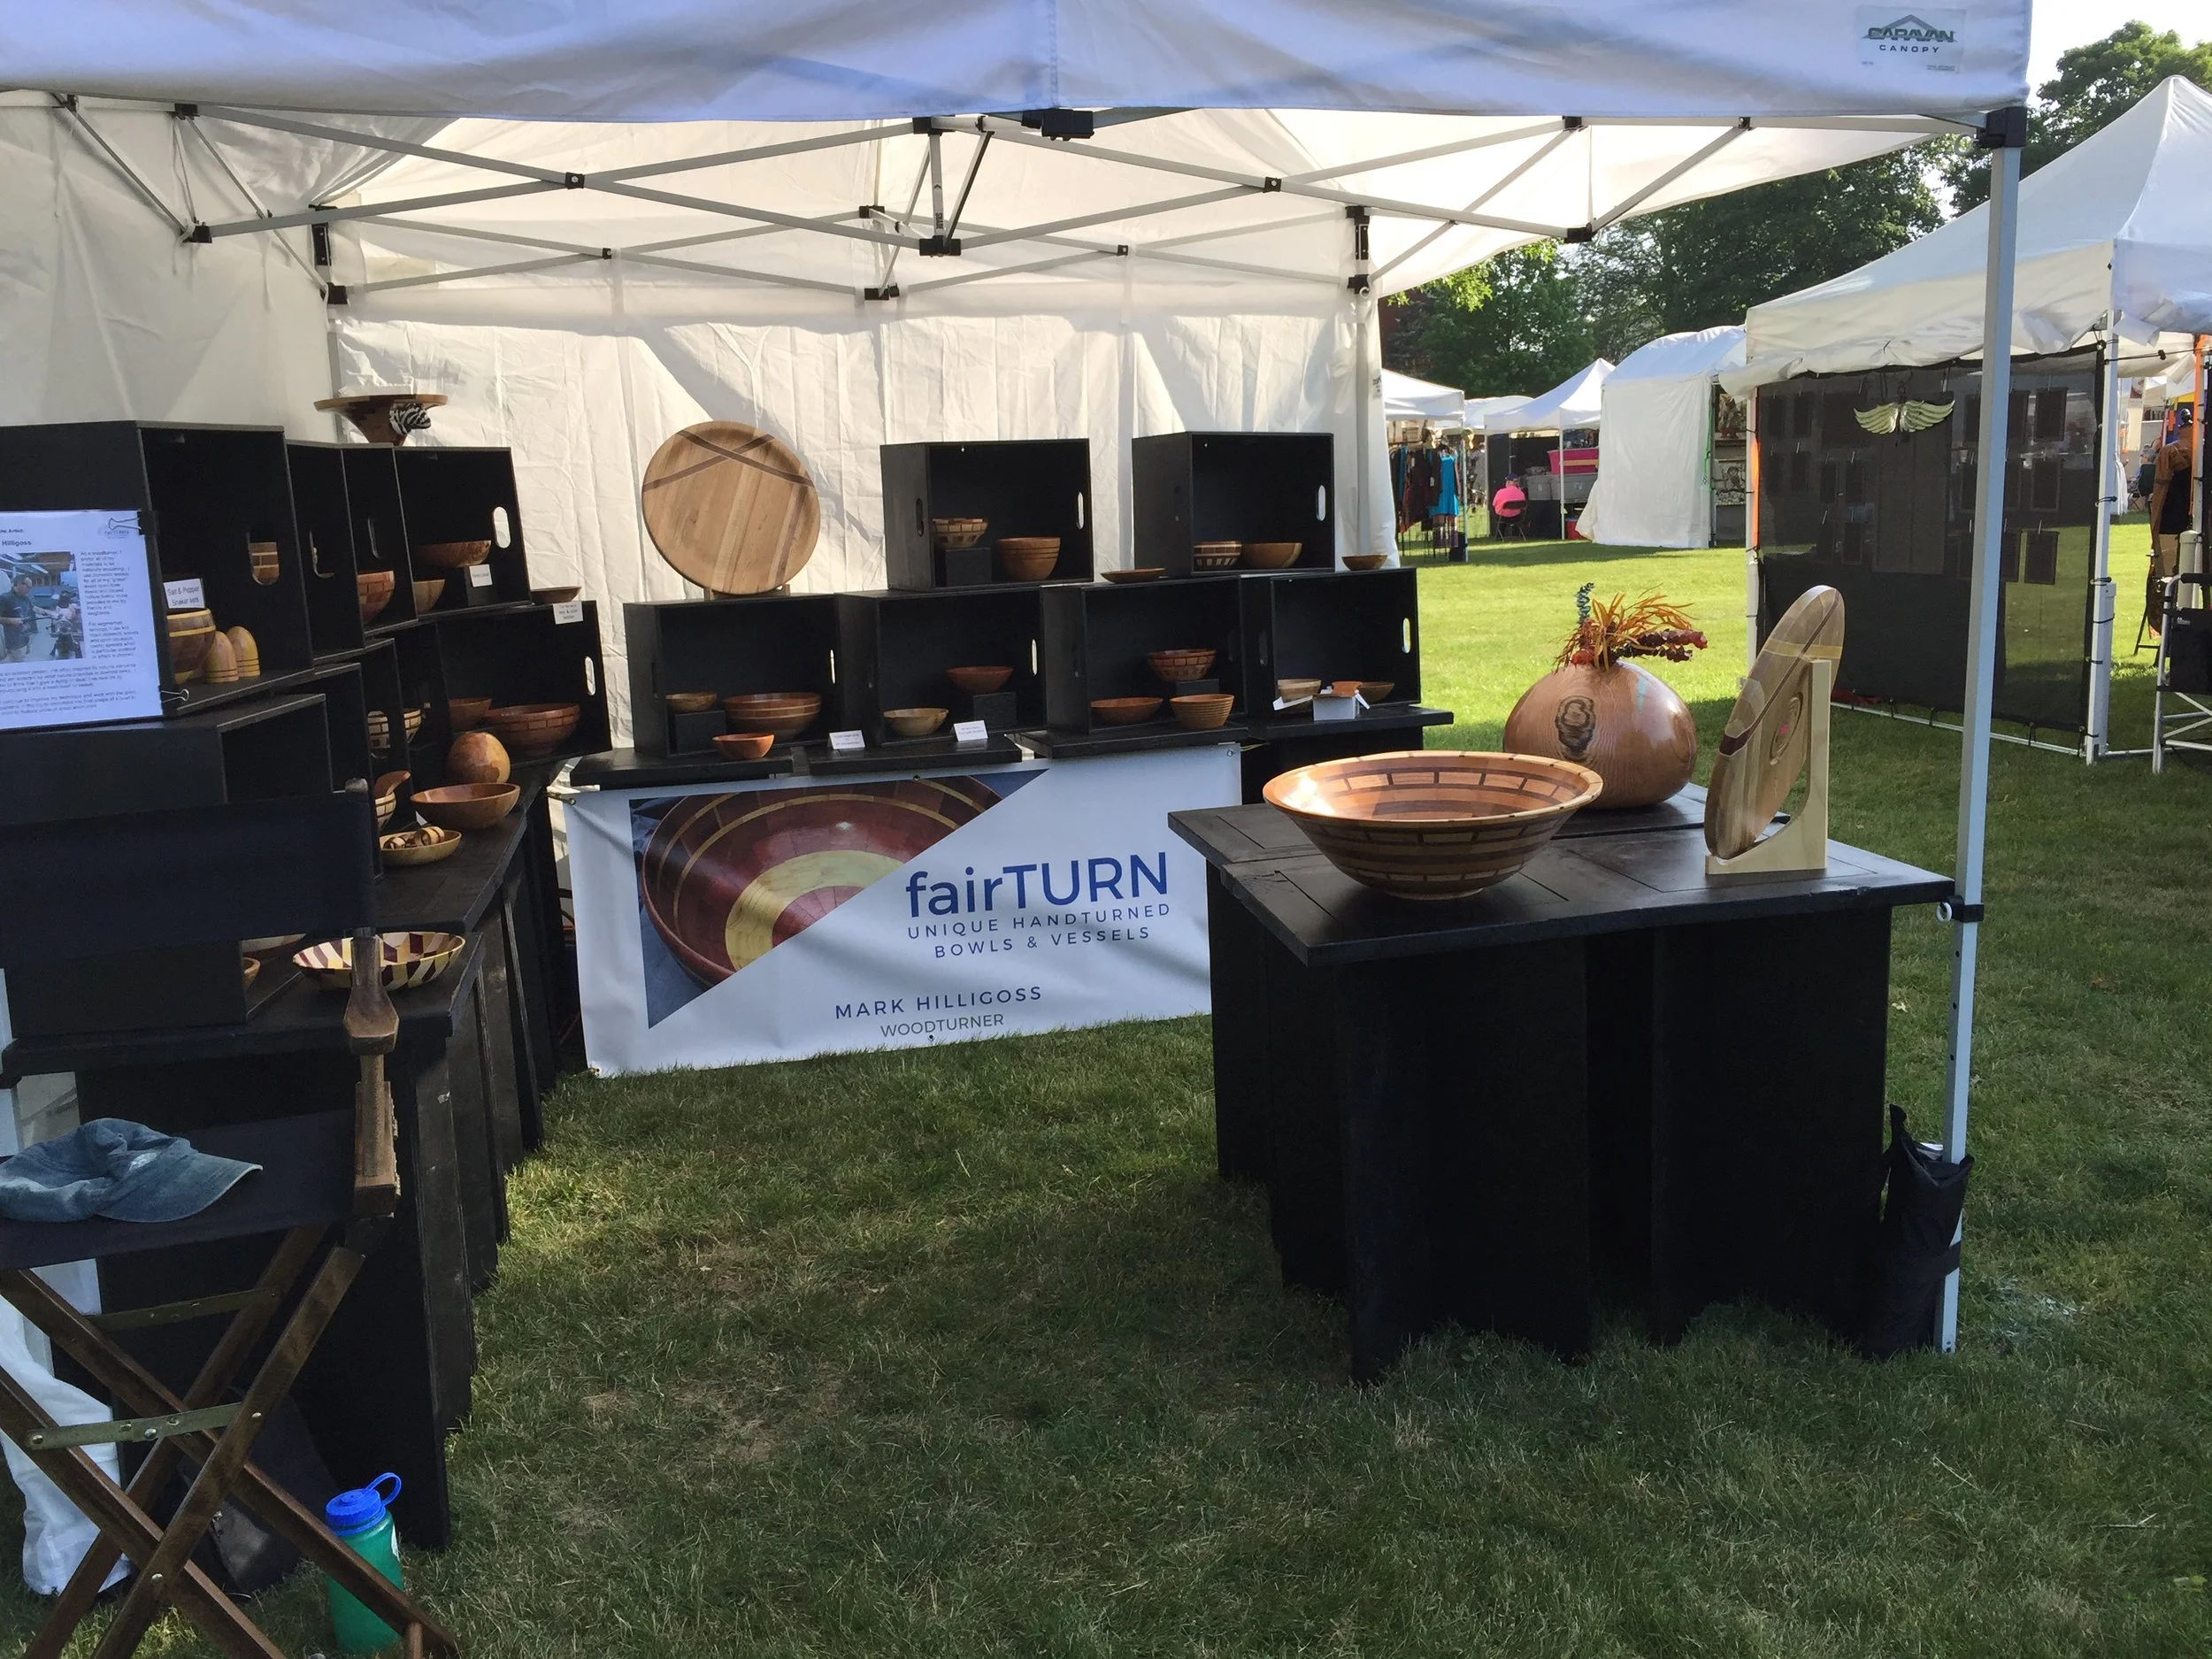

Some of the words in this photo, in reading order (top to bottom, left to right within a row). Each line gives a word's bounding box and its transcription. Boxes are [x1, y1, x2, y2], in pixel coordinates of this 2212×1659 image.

[1867, 27, 1955, 42] CARAVAN
[905, 851, 1168, 918] fairTURN
[908, 918, 999, 940] UNIQUE
[1013, 903, 1170, 929] HANDTURNED
[935, 938, 1013, 958] BOWLS
[1027, 935, 1038, 949] &
[1051, 926, 1149, 946] VESSELS
[835, 998, 904, 1019] MARK
[917, 986, 1041, 1011] HILLIGOSS
[879, 1013, 1004, 1038] WOODTURNER
